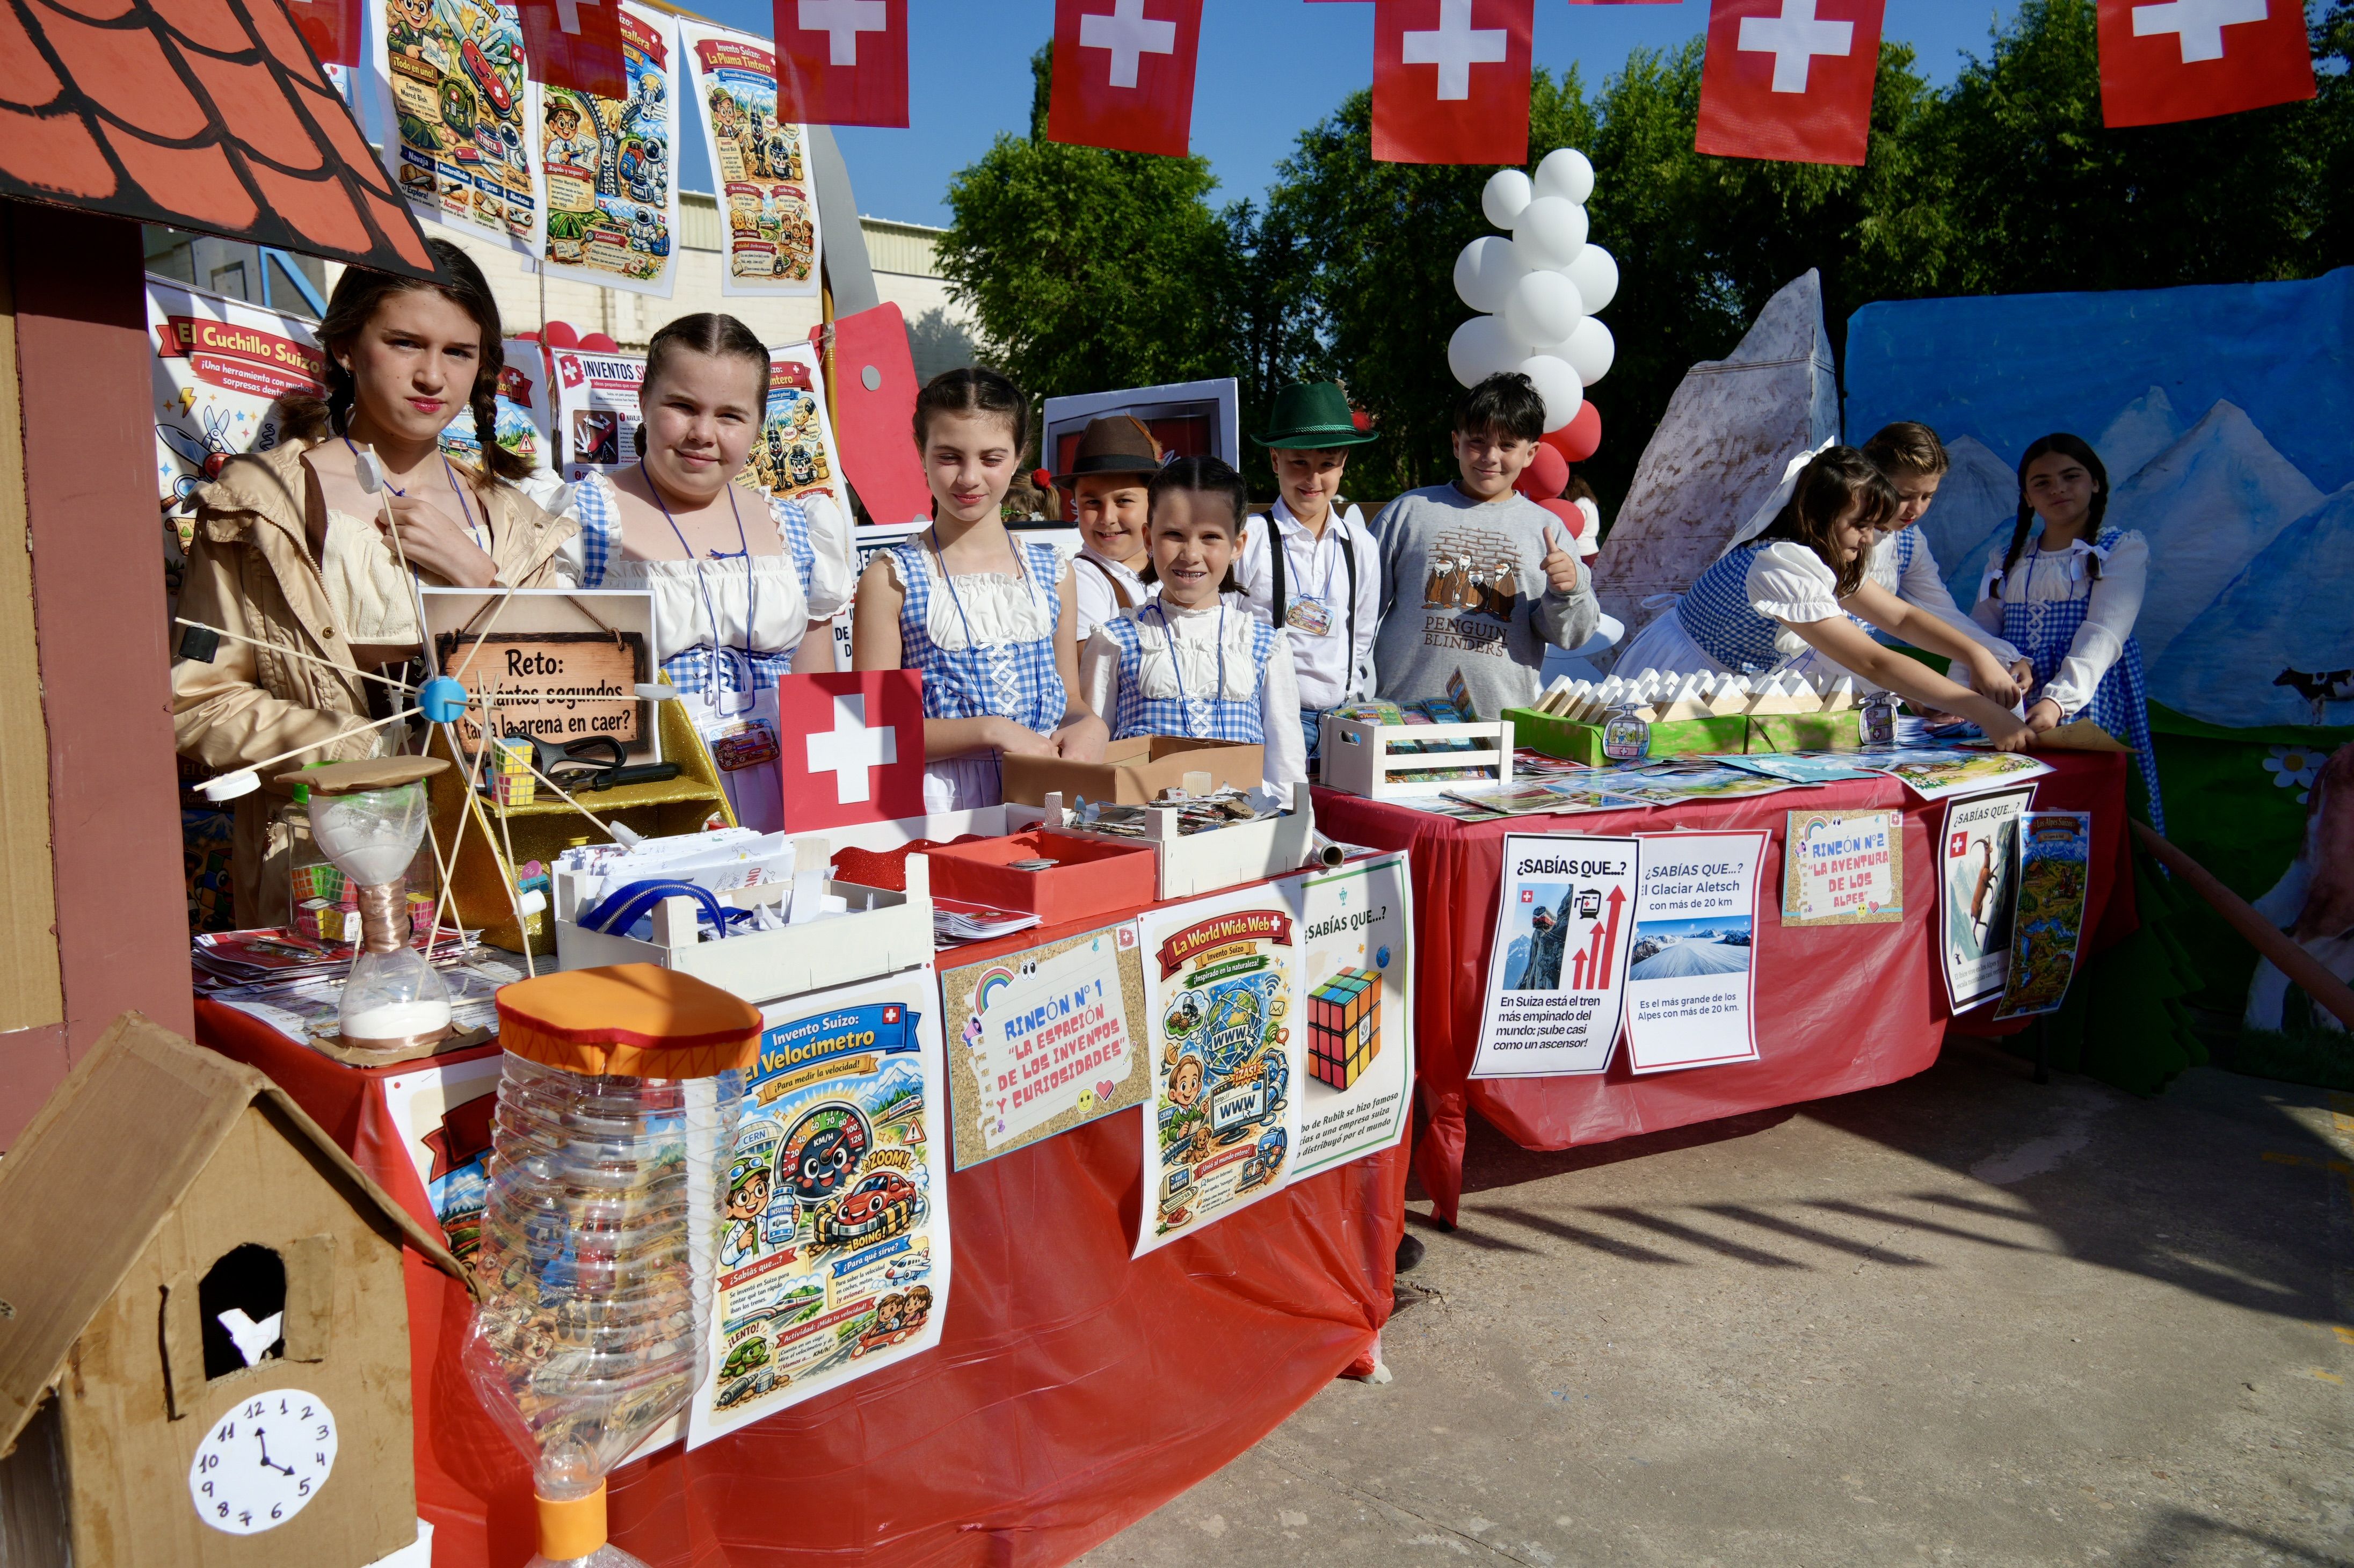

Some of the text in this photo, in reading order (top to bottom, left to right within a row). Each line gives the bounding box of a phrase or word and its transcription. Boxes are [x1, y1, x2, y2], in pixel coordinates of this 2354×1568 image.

[624, 47, 633, 56] 1923
[716, 42, 761, 59] Invento Suizo:
[393, 56, 434, 78] ¡Todo en uno!
[706, 52, 771, 74] La Pluma Tintero
[479, 135, 498, 151] TINTA
[408, 150, 428, 166] Navaja
[439, 163, 470, 182] Destornillador
[547, 165, 564, 173] ¡Rápido
[568, 169, 584, 177] seguro!
[481, 180, 499, 193] Tijeras
[633, 187, 644, 197] TINTA
[510, 192, 530, 206] Abrelatas
[178, 323, 320, 374] El Cuchillo Suizo
[201, 359, 314, 394] ¡Una herramienta con muchas
[583, 360, 634, 380] INVENTOS
[223, 377, 261, 393] sorpresas
[1425, 616, 1507, 643] PENGUIN
[1424, 633, 1503, 657] BLINDERS
[505, 649, 563, 677] Reto:
[547, 679, 623, 709] segundos
[520, 718, 563, 735] arena
[569, 717, 586, 732] en
[592, 710, 630, 731] caer?
[1954, 802, 2020, 827] ¿SABÍAS QUE...?
[2046, 817, 2058, 826] Alpes
[1812, 836, 1861, 858] RINCÓN
[1517, 855, 1627, 878] ¿SABÍAS QUE...?
[1645, 862, 1744, 880] ¿SABÍAS QUE...?
[1831, 851, 1889, 873] AVENTURA
[1651, 880, 1740, 896] Glaciar Aletsch
[1829, 872, 1872, 892] DE LOS
[1650, 897, 1732, 910] con más de 20 km
[1350, 906, 1386, 931] QUE...?
[1172, 916, 1270, 957] La World Wide Web
[1207, 945, 1244, 961] Invento Suizo
[1194, 970, 1219, 985] ¡Inspirado
[1232, 959, 1259, 971] naturaleza!
[1004, 996, 1071, 1041] RINCÓN
[1094, 978, 1102, 997] 1
[1500, 996, 1600, 1007] En Suiza está el tren
[1640, 992, 1737, 1009] Es el más grande de los
[1498, 1010, 1592, 1023] más empinado del
[1637, 1003, 1739, 1021] Alpes con más de 20 km.
[772, 1015, 859, 1047] Invento Suizo:
[1036, 1004, 1105, 1049] ESTACIÓN
[1496, 1025, 1587, 1037] mundo: ¡sube casi
[1214, 1027, 1247, 1047] WWW
[1493, 1038, 1588, 1050] como un ascensor!
[760, 1030, 875, 1073] Velocímetro
[997, 1018, 1120, 1092] DE LOS INVENTOS
[774, 1060, 860, 1093] ¡Para medir la velocidad!
[1235, 1065, 1258, 1081] ¡ZAS!
[996, 1098, 1007, 1114] Y
[1160, 1109, 1173, 1119] CERN
[1220, 1094, 1256, 1119] WWW
[1312, 1120, 1321, 1129] de
[1323, 1111, 1345, 1125] Rubik
[1356, 1102, 1371, 1113] hizo
[1372, 1092, 1398, 1109] famoso
[743, 1130, 766, 1145] CERN
[813, 1133, 834, 1147] KM/H
[861, 1150, 910, 1173] ¡ZOOM!
[1171, 1177, 1188, 1190] WEBSITE
[769, 1206, 793, 1216] INSULINA
[852, 1226, 886, 1251] BOING!
[843, 1259, 863, 1273] ¿Para
[864, 1252, 877, 1262] qué
[728, 1322, 760, 1348] ¡LENTO!
[244, 1401, 265, 1419] 12
[280, 1398, 289, 1415] 1
[301, 1406, 314, 1420] 2
[217, 1422, 235, 1442] 11
[316, 1425, 330, 1441] 3
[199, 1454, 219, 1473] 10
[316, 1451, 325, 1467] 4
[201, 1481, 214, 1498] 9
[298, 1477, 311, 1497] 5
[217, 1501, 229, 1518] 8
[238, 1511, 252, 1526] 7
[271, 1502, 282, 1519] 6
